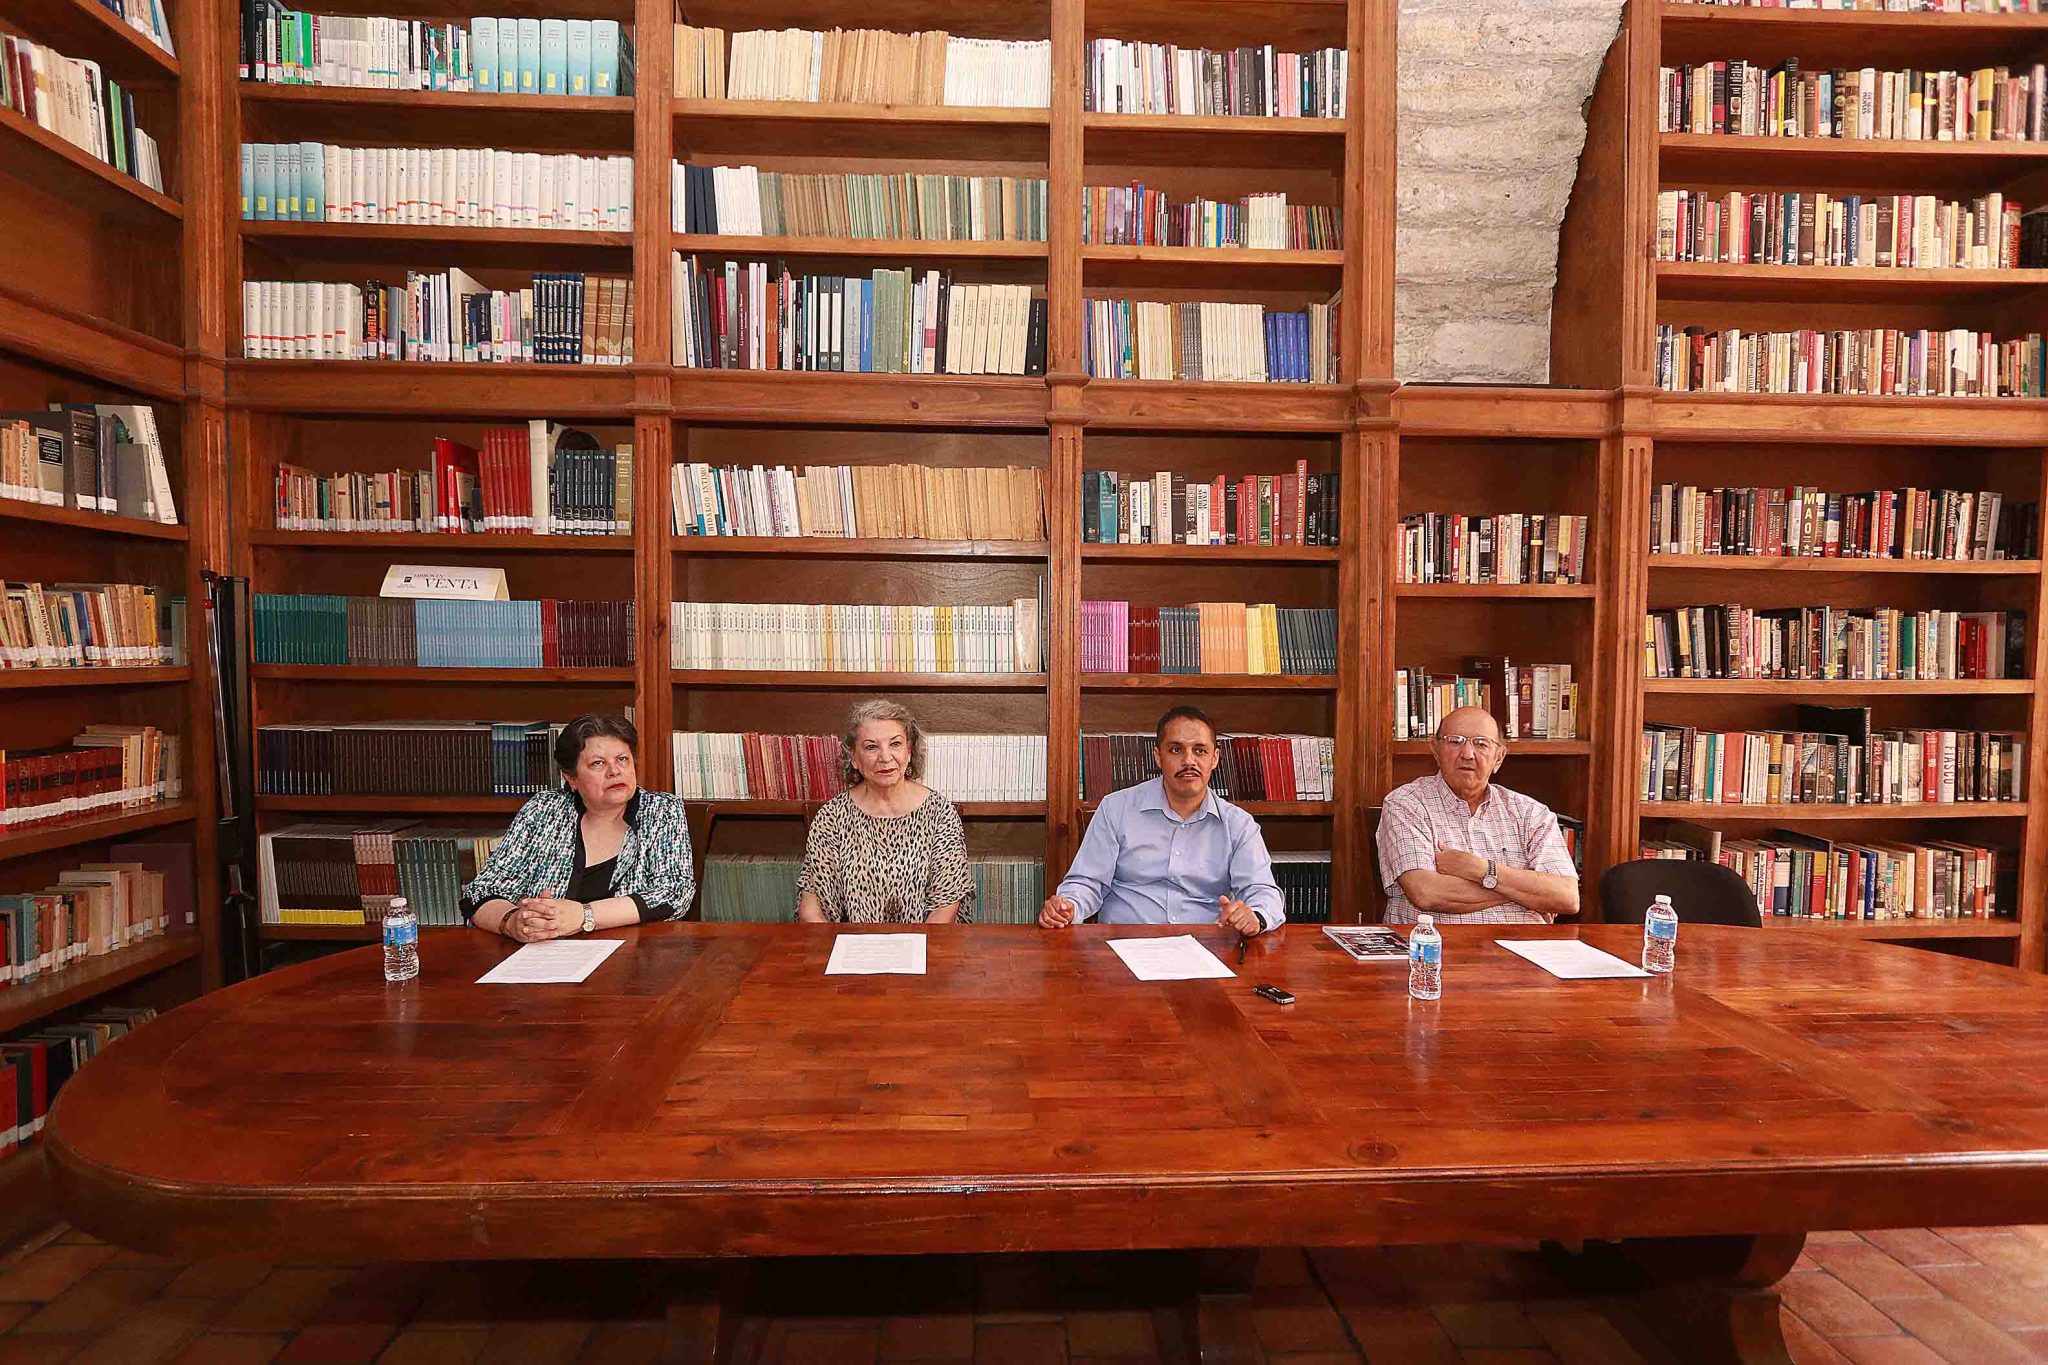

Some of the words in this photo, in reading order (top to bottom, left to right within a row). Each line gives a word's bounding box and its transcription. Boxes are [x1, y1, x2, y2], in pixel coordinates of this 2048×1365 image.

[703, 501, 715, 532] HIDALGO
[1188, 489, 1196, 522] CRUSADES
[1803, 493, 1816, 534] MAO
[1977, 495, 1989, 539] AFRICA
[424, 577, 479, 591] VENTA
[1943, 746, 1955, 785] FIASCO
